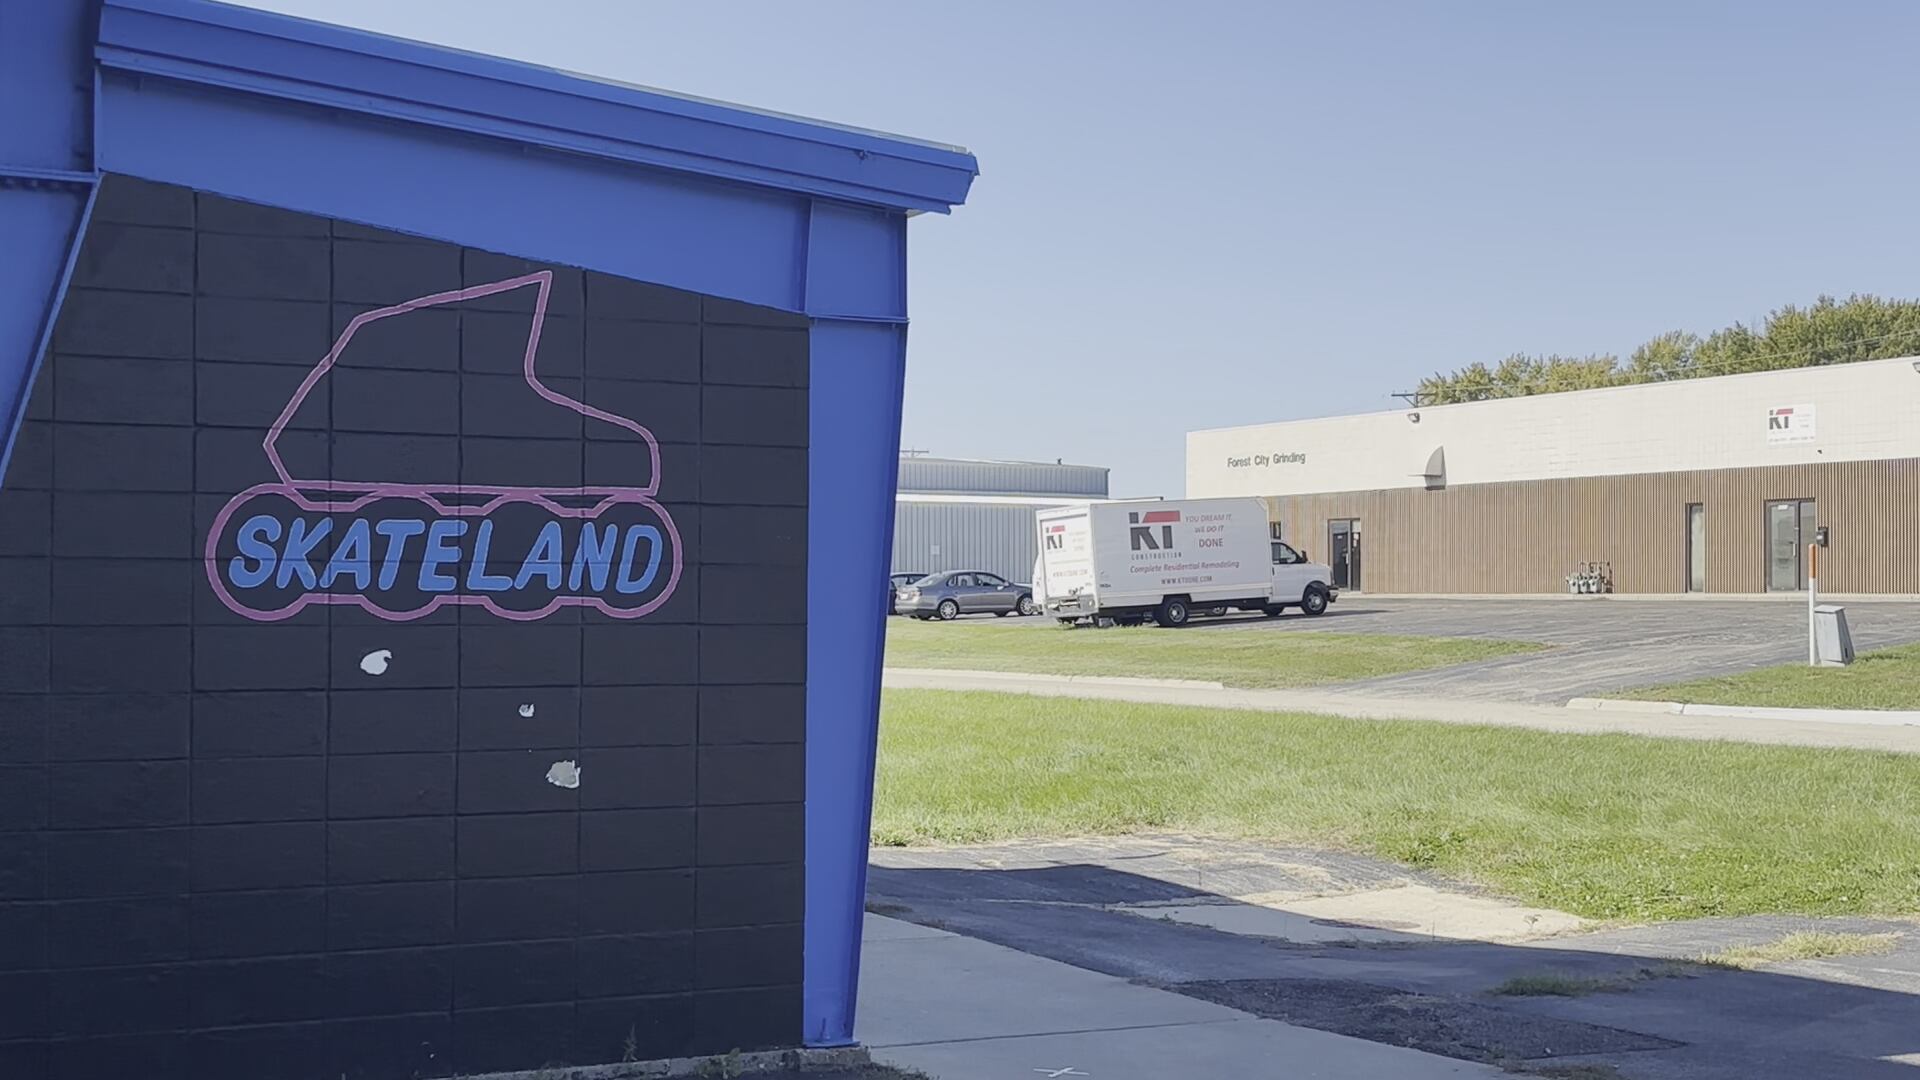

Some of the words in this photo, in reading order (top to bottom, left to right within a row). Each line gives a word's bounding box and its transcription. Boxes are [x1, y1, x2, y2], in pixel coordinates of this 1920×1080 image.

[1769, 408, 1793, 430] KT
[1227, 457, 1251, 467] Forest
[1254, 455, 1270, 467] City
[1273, 453, 1306, 464] Grinding
[1201, 514, 1224, 522] DREAM
[1046, 525, 1066, 550] KT
[1129, 511, 1181, 550] KT
[1199, 538, 1223, 548] DONE
[228, 515, 663, 594] SKATELAND
[1131, 552, 1182, 560] CONSTRUCTION
[1130, 564, 1162, 573] Complete
[1163, 562, 1200, 571] Residential
[1201, 561, 1240, 569] Remodeling
